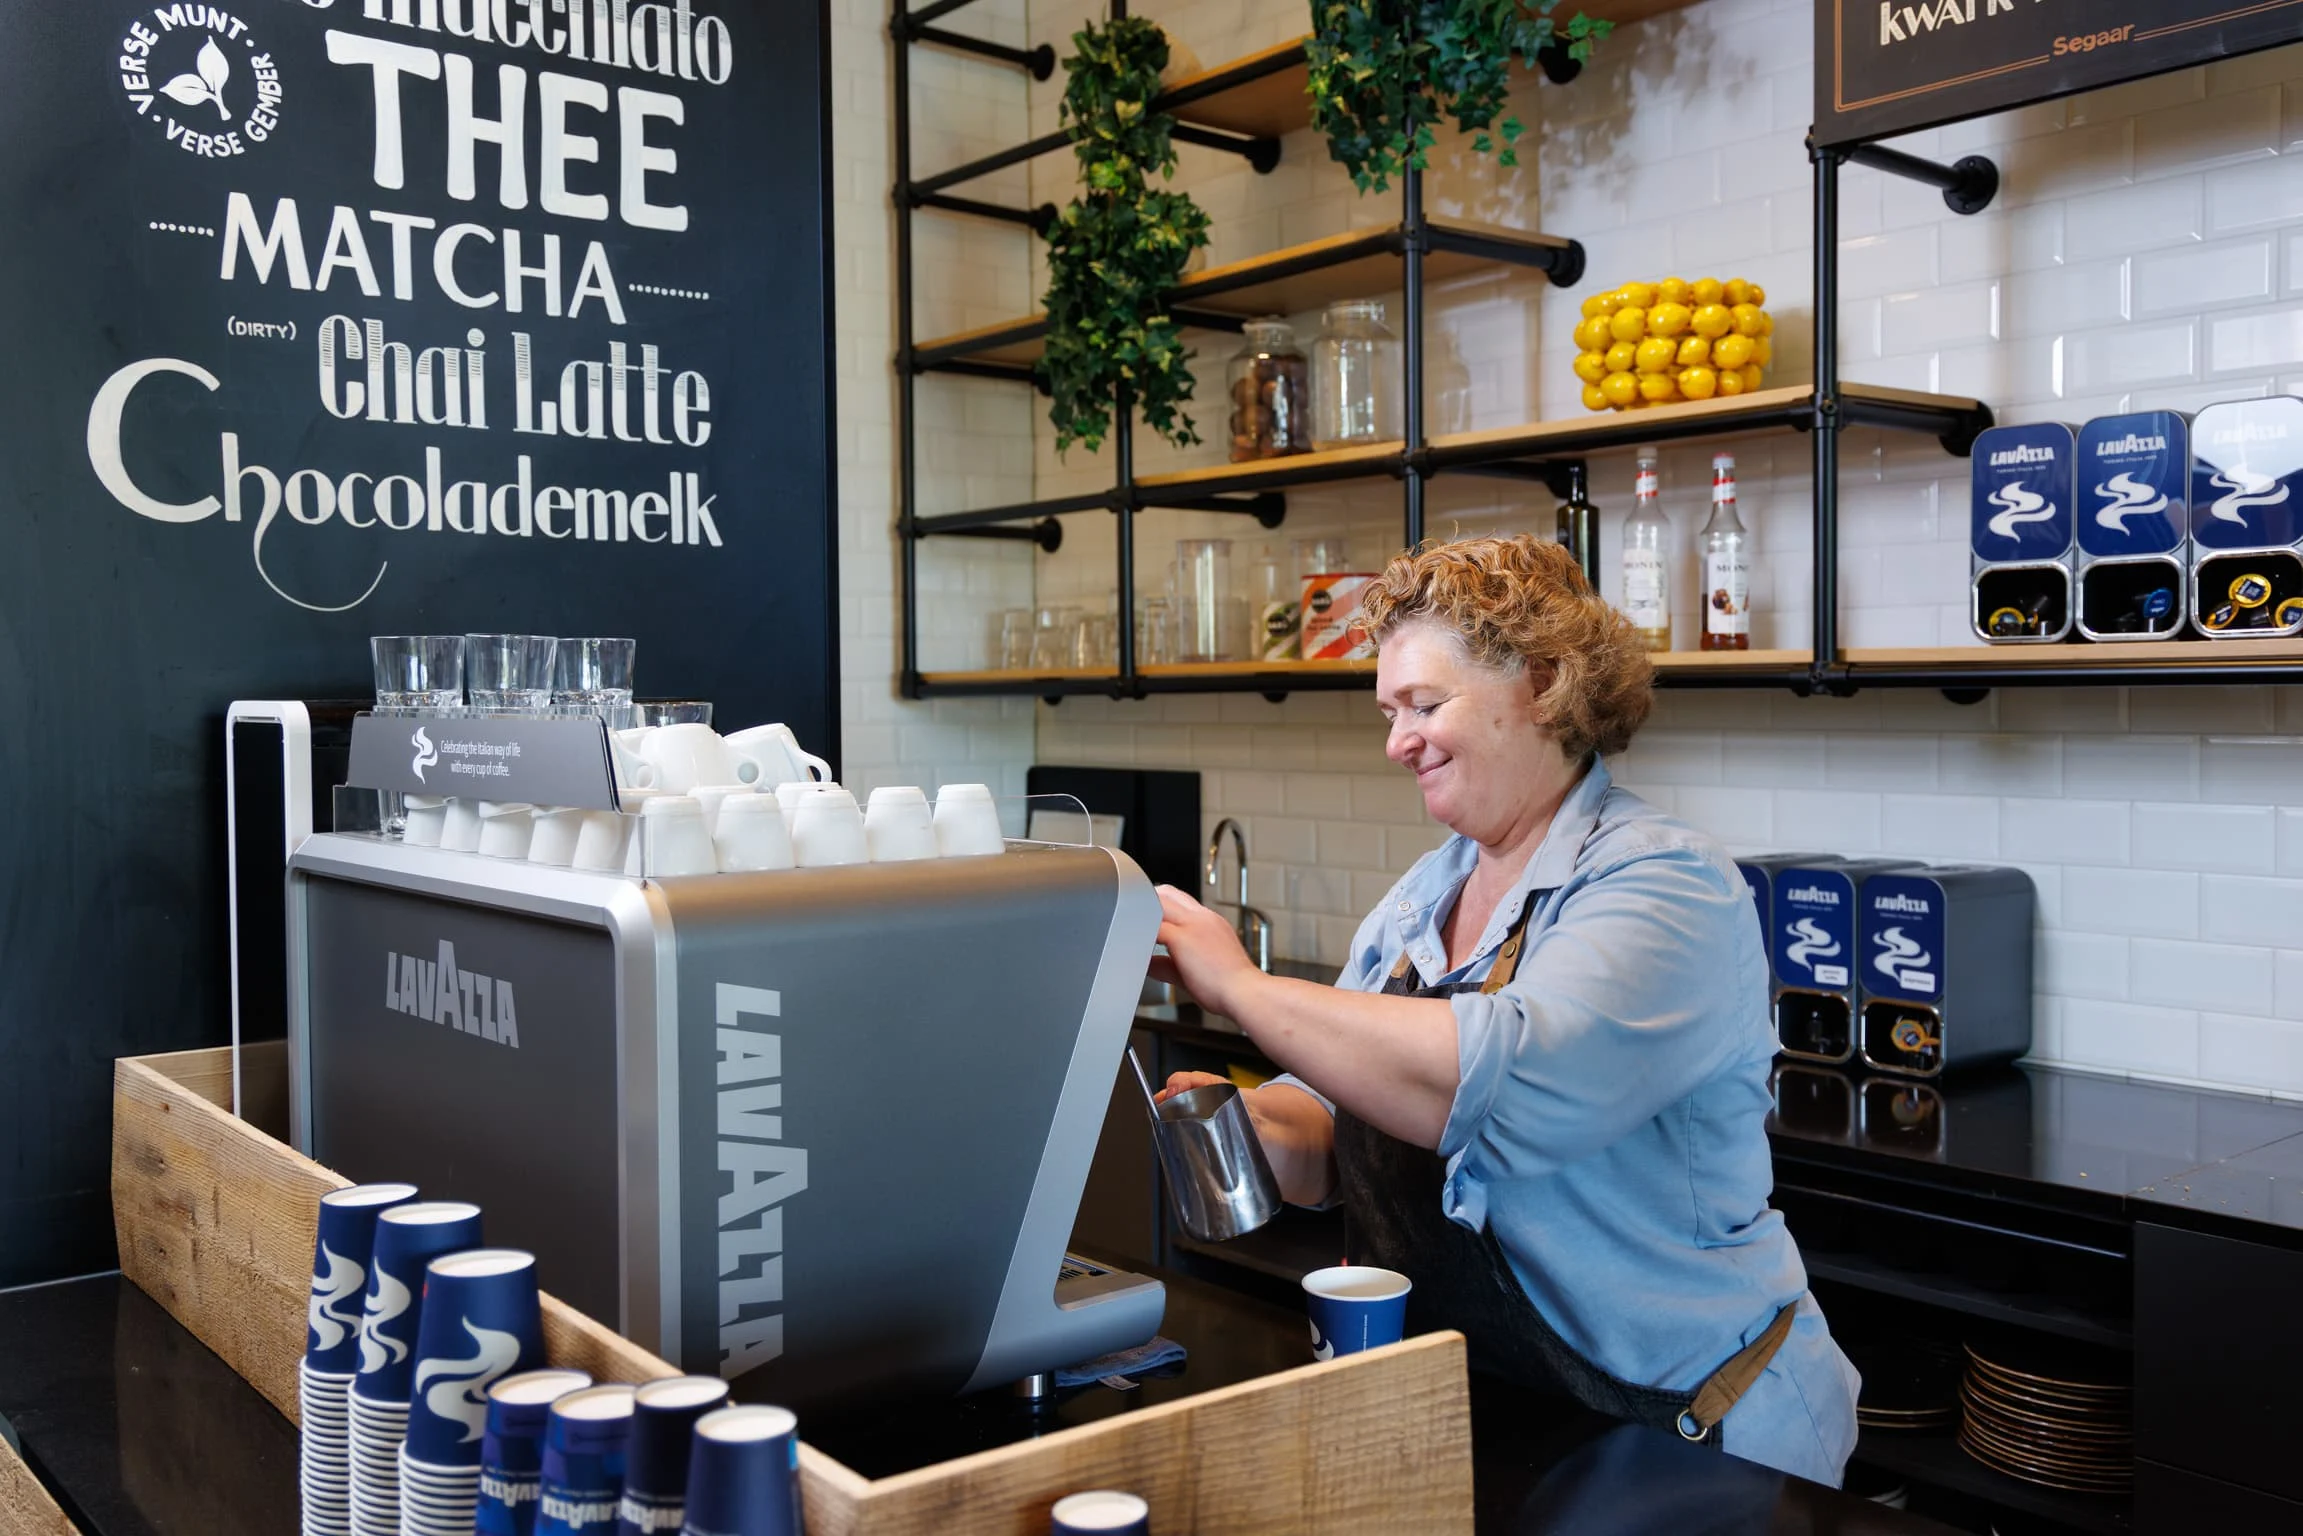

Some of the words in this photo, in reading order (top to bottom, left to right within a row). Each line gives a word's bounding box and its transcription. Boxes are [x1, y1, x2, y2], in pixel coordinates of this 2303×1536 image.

[119, 21, 159, 116] VERSE
[154, 3, 248, 40] MUNT
[2052, 23, 2136, 55] Segaar
[166, 118, 245, 158] VERSE
[244, 52, 283, 142] GEMBER
[325, 29, 689, 233] THEE
[220, 191, 627, 325] MATCHA
[227, 315, 297, 341] (DIRTY)
[318, 314, 490, 431] Chai
[511, 331, 712, 447] Latte
[1990, 444, 2055, 466] LAVAZZA
[2096, 433, 2167, 456] LAVAZZA
[87, 357, 724, 612] Chocolademelk
[440, 739, 469, 758] Celebrating
[468, 741, 478, 754] the
[1786, 885, 1840, 905] LAVAZZA
[1874, 893, 1930, 914] LAVAZZA
[385, 939, 520, 1049] LAVAZZA
[715, 981, 809, 1382] LAVAZZA
[480, 1473, 541, 1508] AVAZZA
[621, 1496, 685, 1534] AVAZZA
